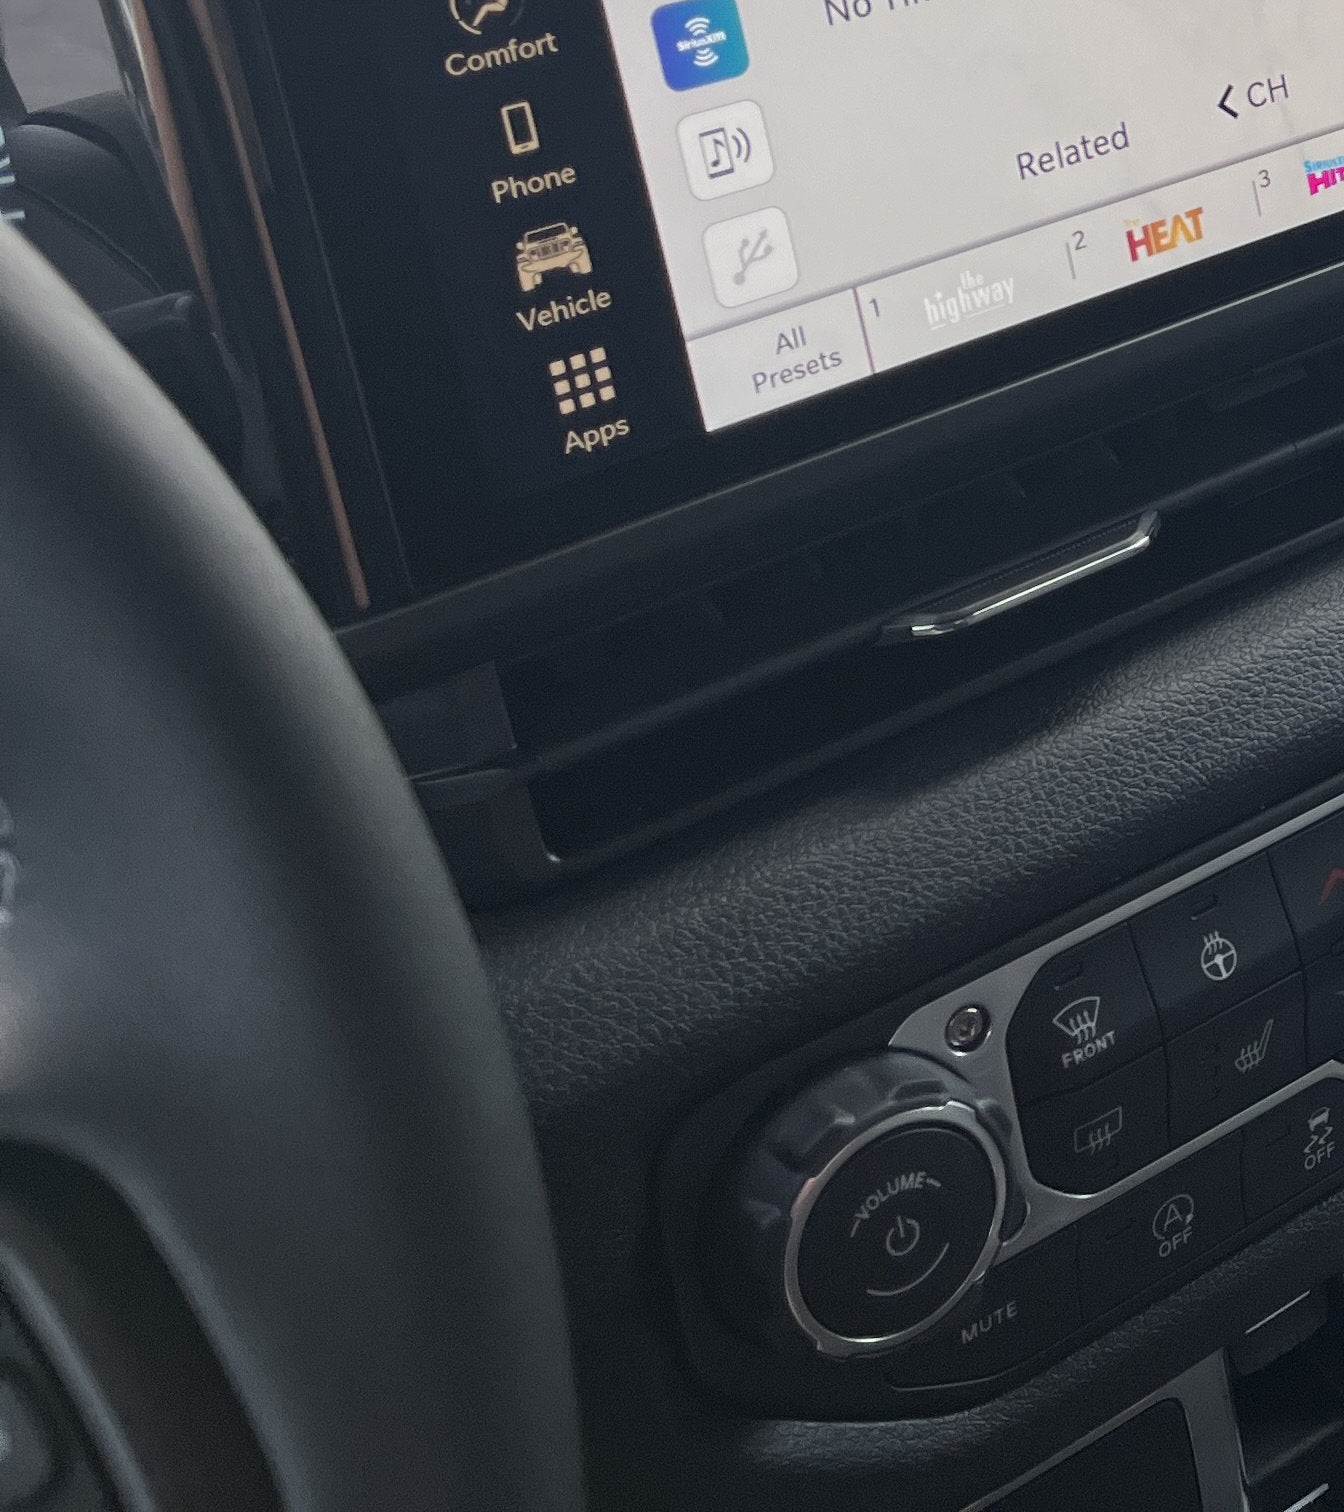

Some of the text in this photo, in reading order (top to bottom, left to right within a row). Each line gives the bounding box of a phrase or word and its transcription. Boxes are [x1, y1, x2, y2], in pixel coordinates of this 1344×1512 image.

[444, 31, 559, 77] Comfort
[1246, 75, 1290, 110] CH
[1016, 121, 1130, 181] Related
[490, 163, 577, 204] Phone
[1258, 169, 1272, 188] 3
[1071, 230, 1088, 251] 2
[1126, 206, 1204, 263] HEAT
[960, 270, 984, 289] the
[515, 288, 613, 332] Vehicle
[867, 298, 882, 318] 1
[923, 277, 1014, 324] highway
[774, 326, 808, 356] All
[751, 348, 843, 395] Presets
[563, 418, 631, 455] Apps
[1061, 1028, 1118, 1068] FRONT
[1302, 1140, 1336, 1171] OFF
[854, 1171, 927, 1220] VOLUME
[1158, 1226, 1193, 1258] OFF
[961, 1301, 1019, 1346] MUTE
